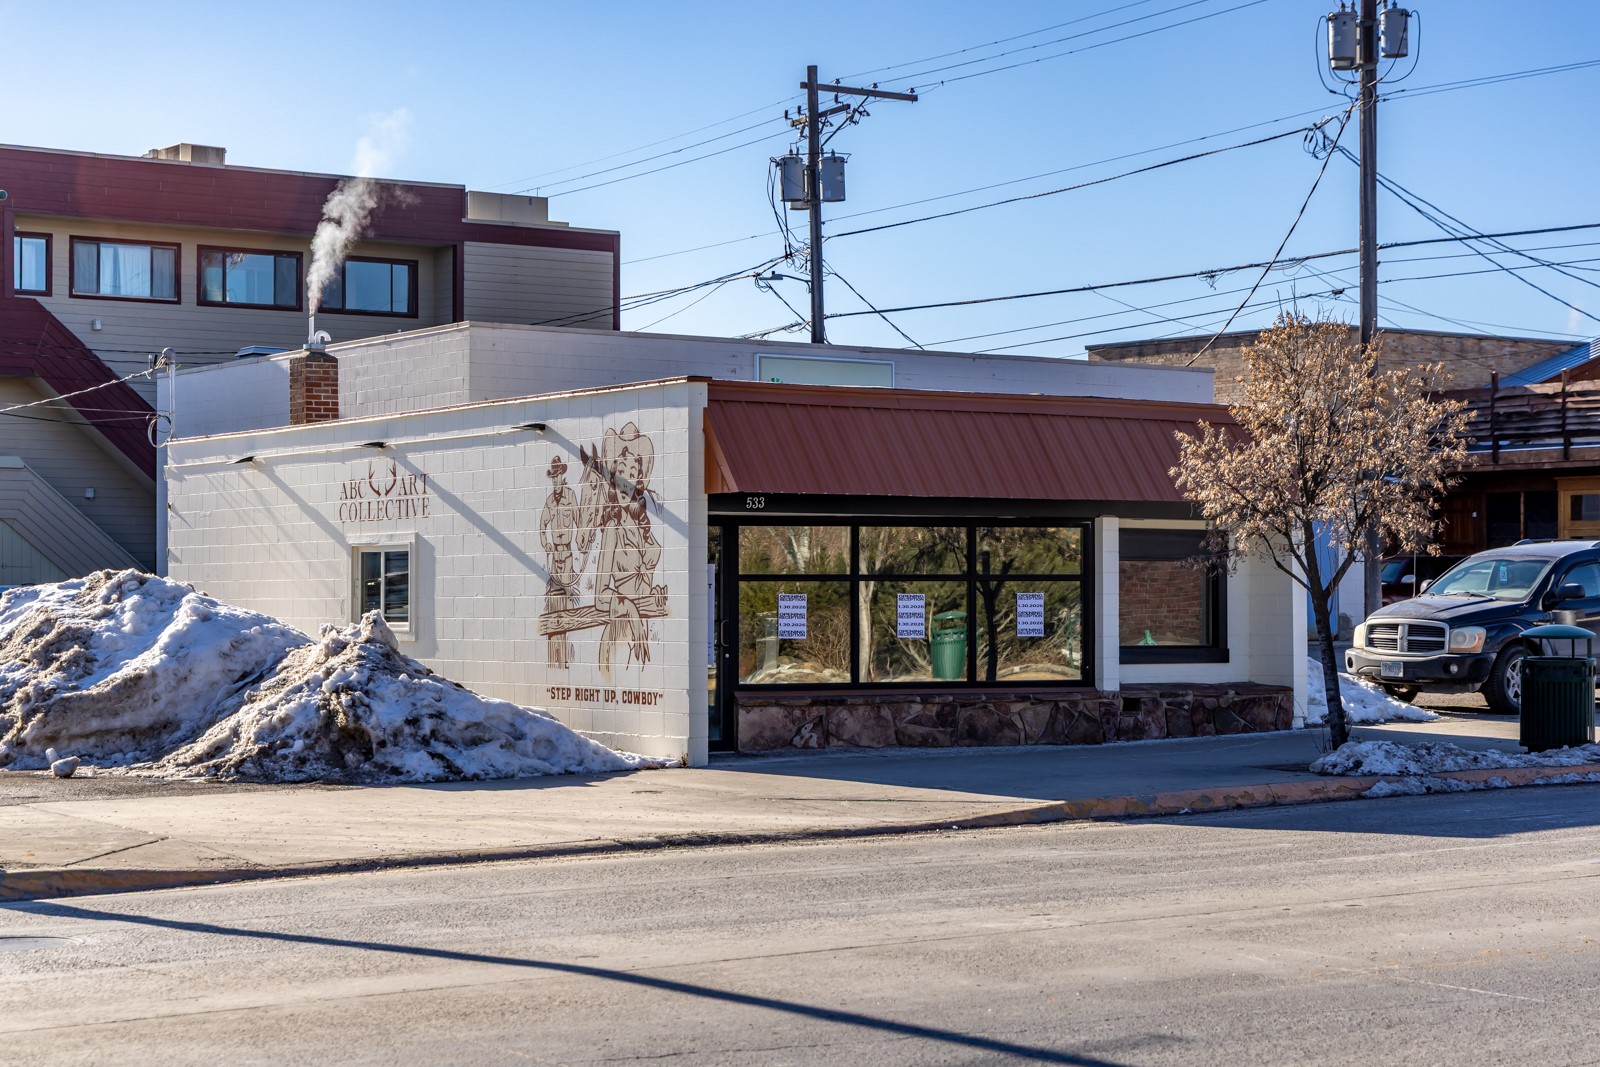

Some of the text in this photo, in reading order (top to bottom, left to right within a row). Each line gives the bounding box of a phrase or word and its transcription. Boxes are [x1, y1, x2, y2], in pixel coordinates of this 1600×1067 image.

[340, 473, 429, 500] ABC ART
[339, 497, 431, 523] COLLECTIVE
[746, 496, 765, 509] 533
[575, 688, 600, 702] RIGHT
[604, 690, 618, 704] UP,
